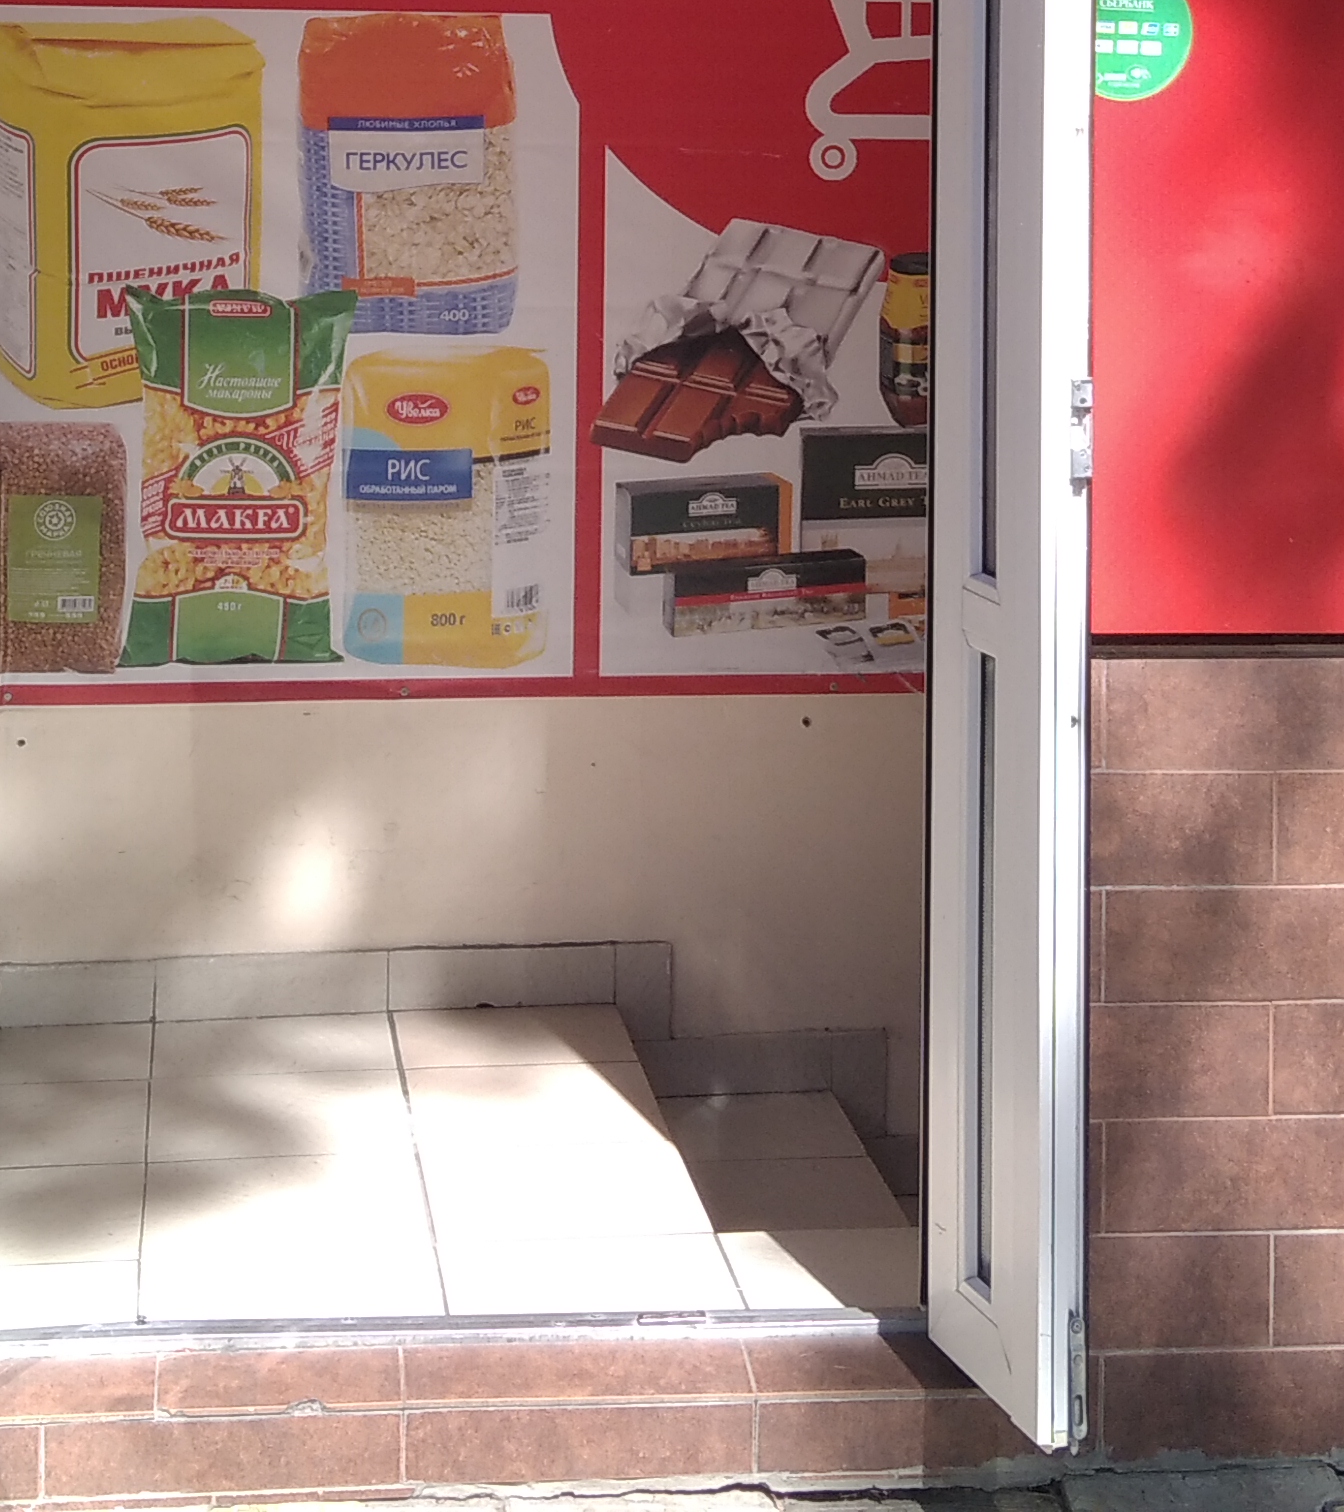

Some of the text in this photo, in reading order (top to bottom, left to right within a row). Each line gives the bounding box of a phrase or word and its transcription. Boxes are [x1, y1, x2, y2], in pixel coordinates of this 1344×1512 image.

[357, 119, 457, 129] ЛЮБИМЫЕ ХЛОПЬЯ
[345, 150, 468, 171] ГЕРКУЛЕС
[88, 251, 241, 284] ПШЕНИЧНАЯ
[440, 310, 469, 321] 400
[100, 353, 139, 372] ОСНО
[197, 362, 282, 389] Настоящие
[206, 388, 273, 402] макароны
[395, 400, 441, 418] Увелка
[387, 459, 431, 481] РИС
[858, 471, 904, 482] AHMAD
[359, 484, 457, 494] ОБРАБОТАННЫЙ ПАРОМ
[175, 508, 291, 529] MAKFA
[430, 613, 466, 627] 800 г
